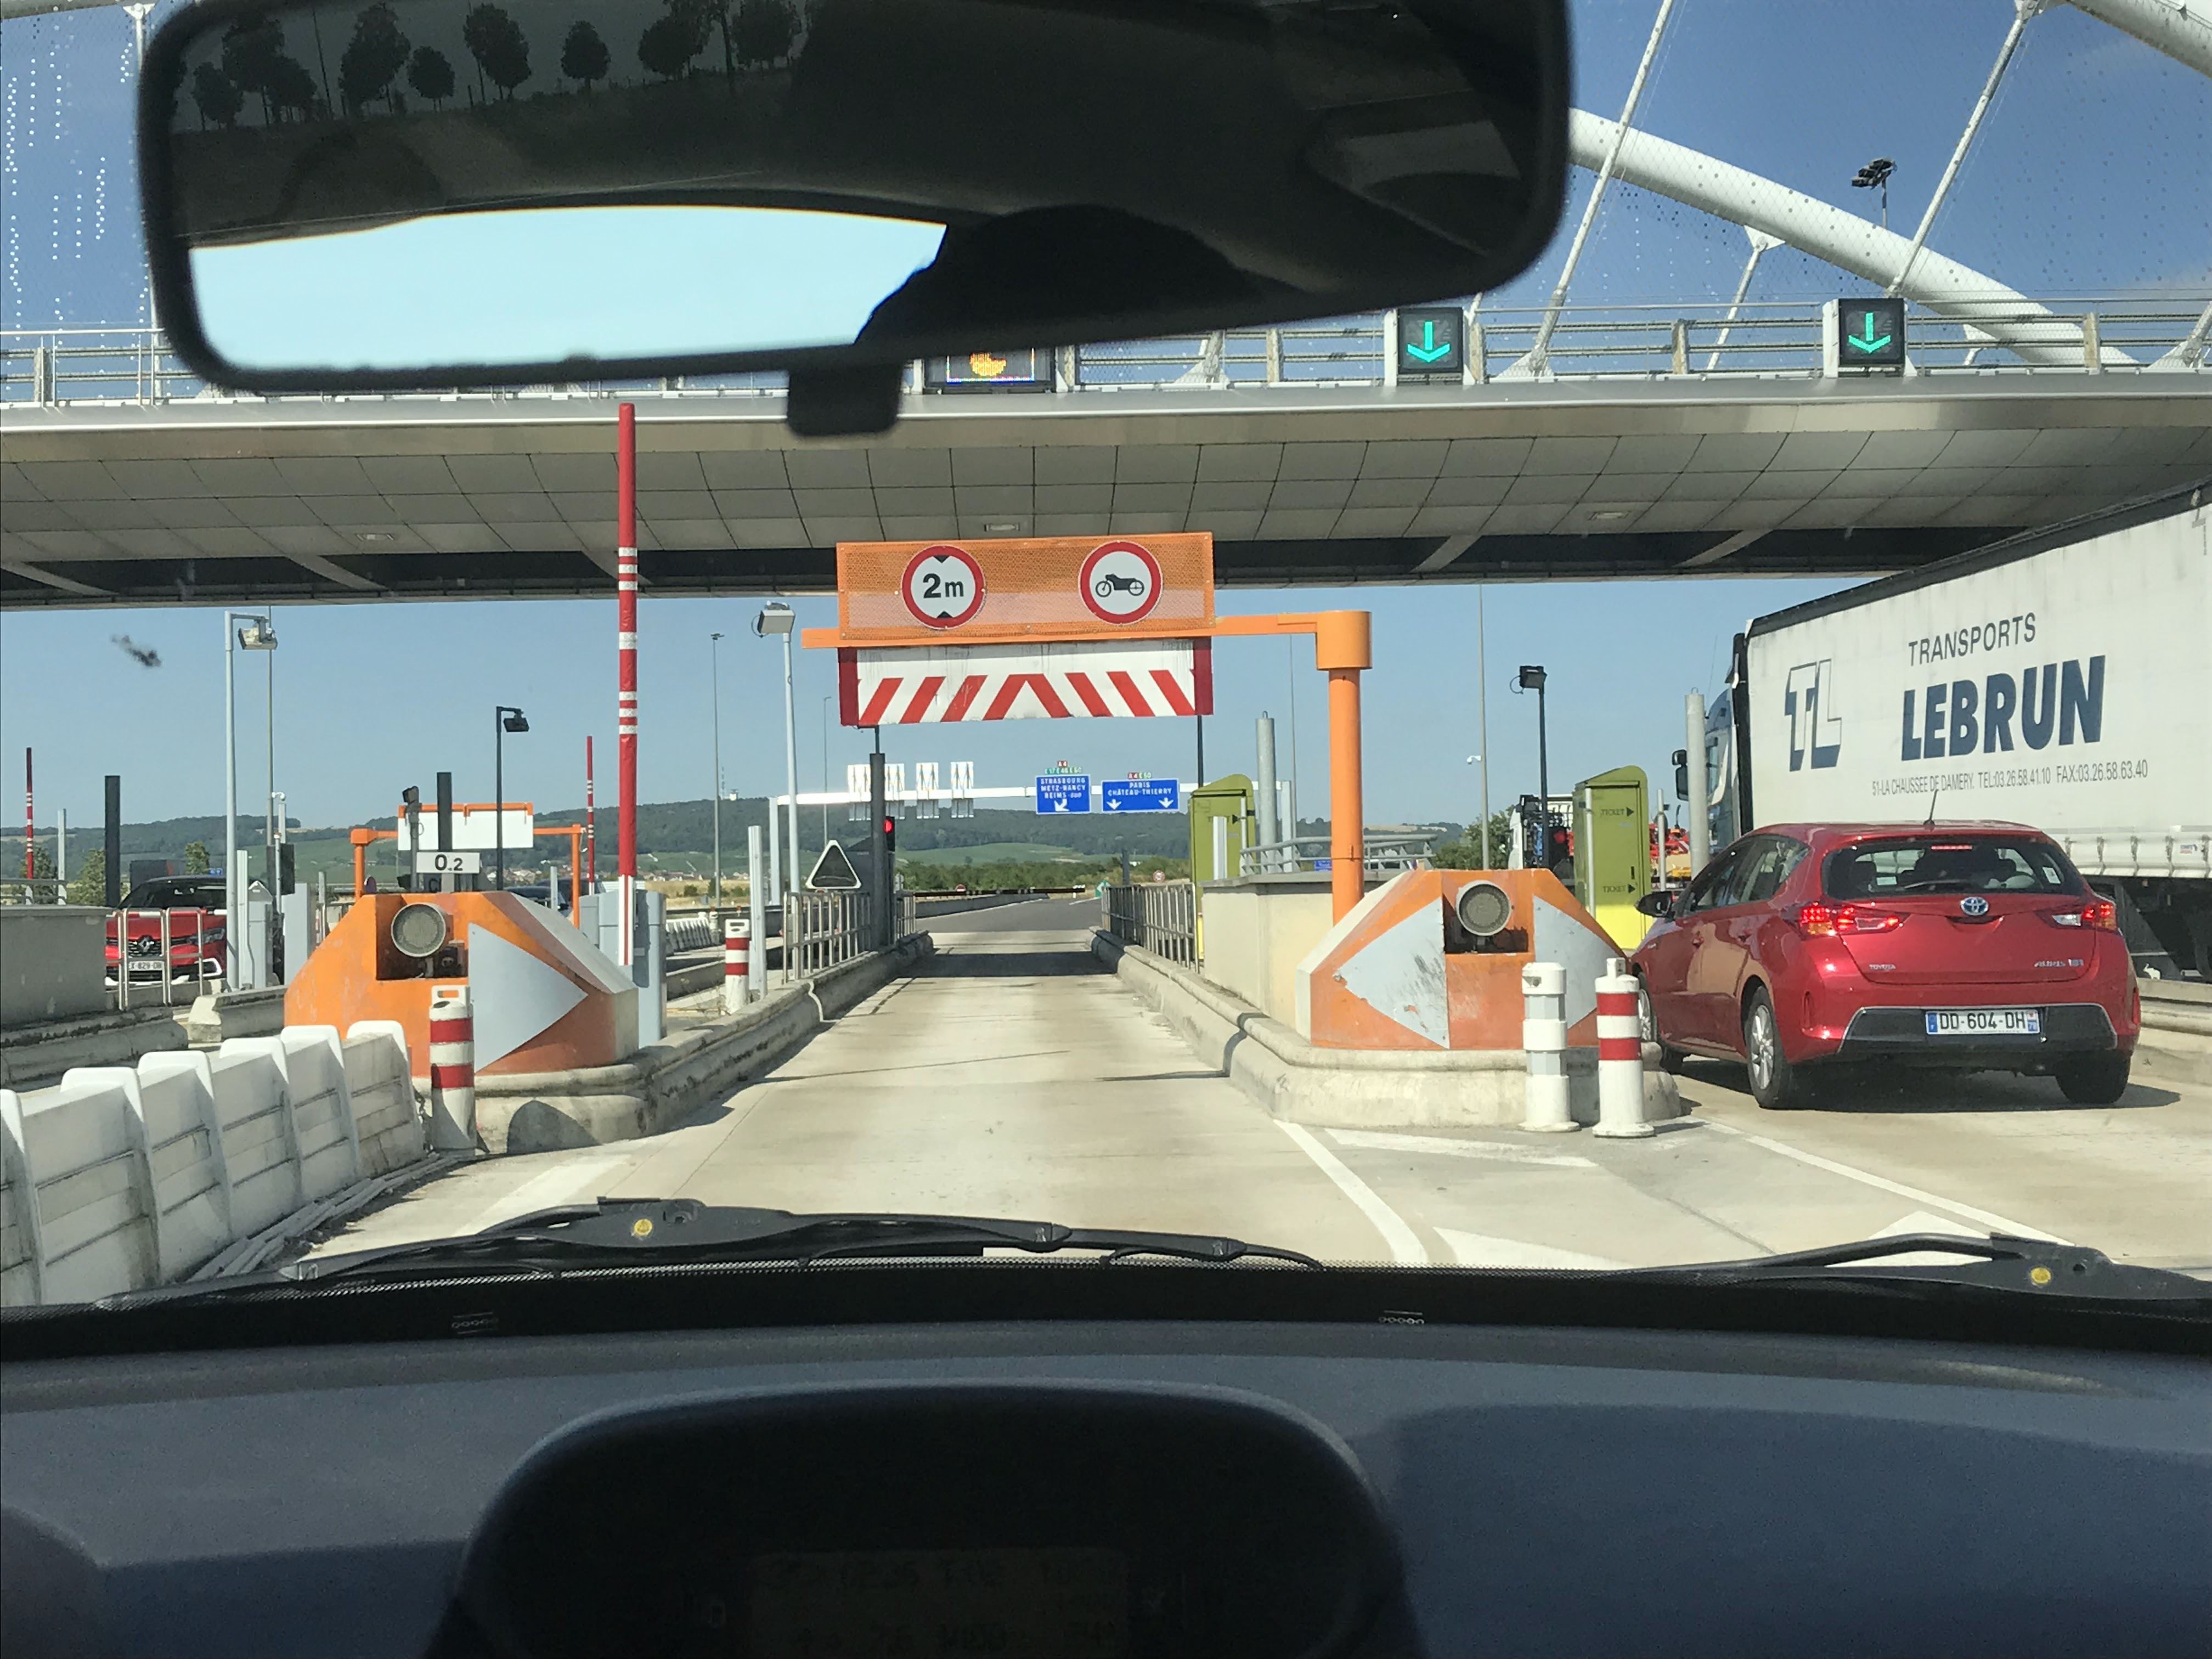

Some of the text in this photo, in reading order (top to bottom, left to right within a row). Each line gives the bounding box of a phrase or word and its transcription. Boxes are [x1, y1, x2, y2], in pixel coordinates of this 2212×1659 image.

[1909, 612, 2036, 667] TRANSPORTS
[1901, 655, 2106, 761] LEBRUN
[1107, 788, 1172, 796] CHÂTEAU-THIERRY
[1892, 776, 1928, 795] CHAUSSEE
[1929, 775, 1939, 792] DE
[1939, 1011, 2026, 1030] DD-604-DH
